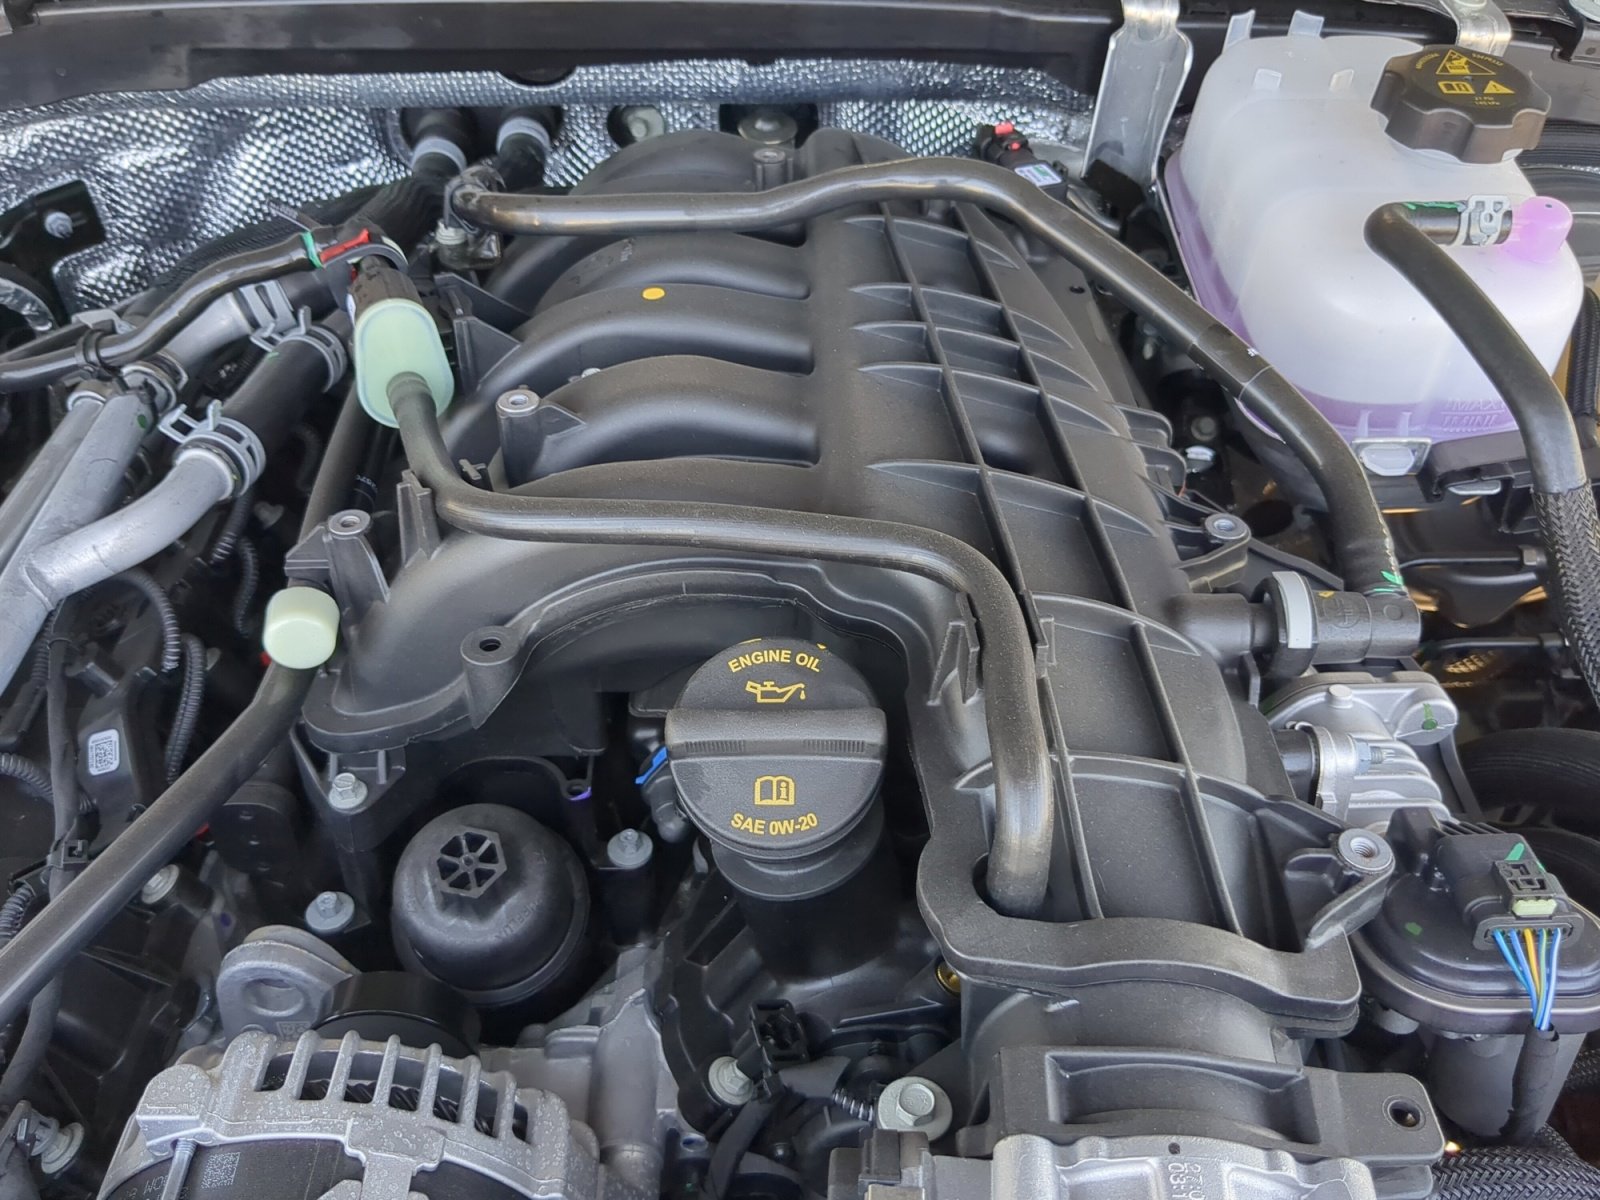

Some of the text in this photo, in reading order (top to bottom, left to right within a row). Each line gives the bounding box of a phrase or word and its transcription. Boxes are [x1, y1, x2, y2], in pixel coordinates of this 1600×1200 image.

[727, 649, 821, 673] ENGINE OIL
[730, 812, 818, 835] SAE 0W-20
